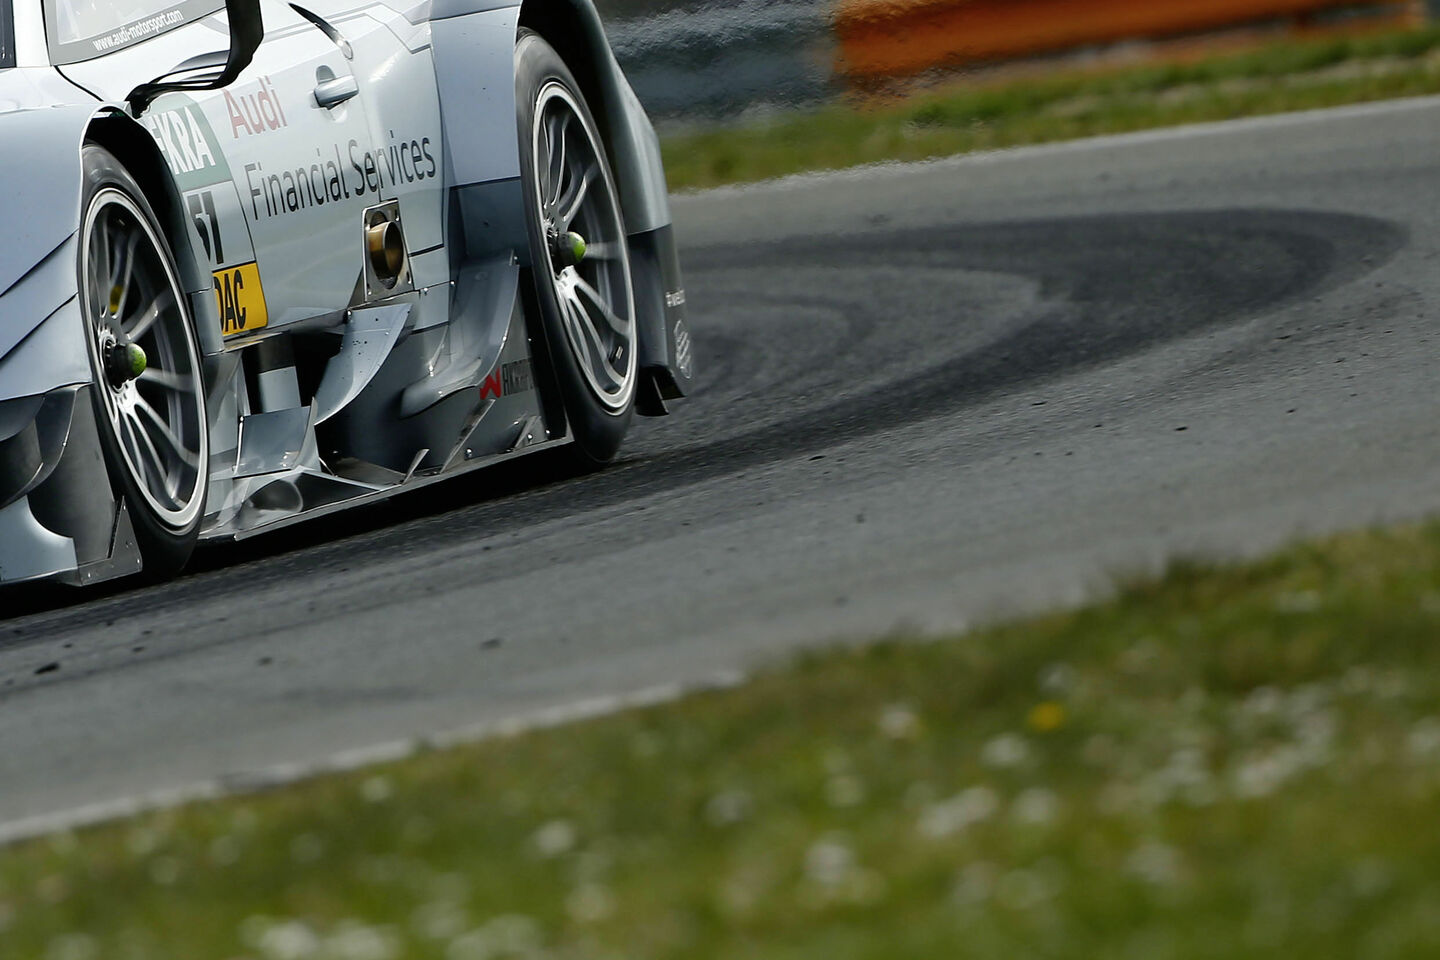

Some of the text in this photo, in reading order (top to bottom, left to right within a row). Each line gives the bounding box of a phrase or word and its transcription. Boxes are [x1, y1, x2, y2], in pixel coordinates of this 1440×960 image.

[92, 9, 184, 51] www.audi-motorsport.com
[222, 75, 288, 138] Audi
[144, 106, 215, 176] EKRA
[244, 130, 436, 220] Financial Services
[214, 269, 248, 332] DAC
